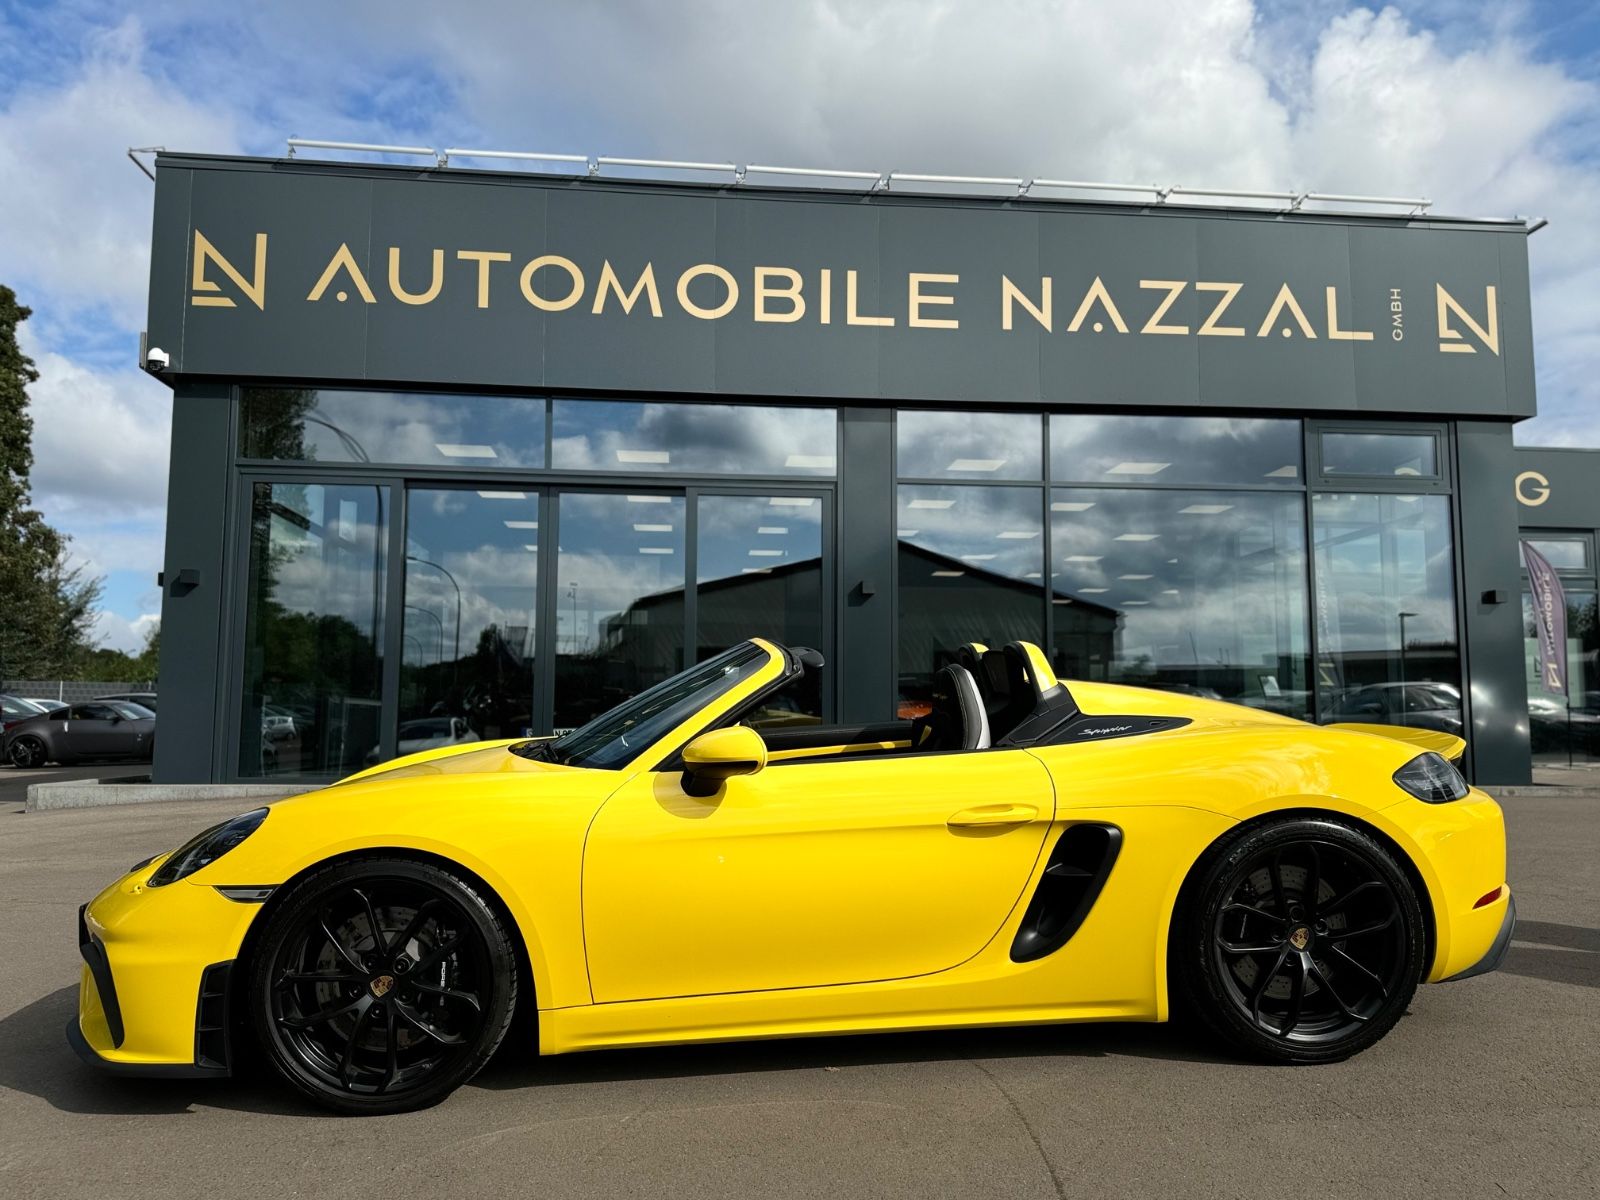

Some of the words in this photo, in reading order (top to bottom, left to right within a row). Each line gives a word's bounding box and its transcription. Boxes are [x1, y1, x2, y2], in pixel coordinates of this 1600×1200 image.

[306, 243, 960, 331] AUTOMOBILE
[1001, 276, 1374, 341] NAZZAL
[1390, 288, 1403, 341] GMBH
